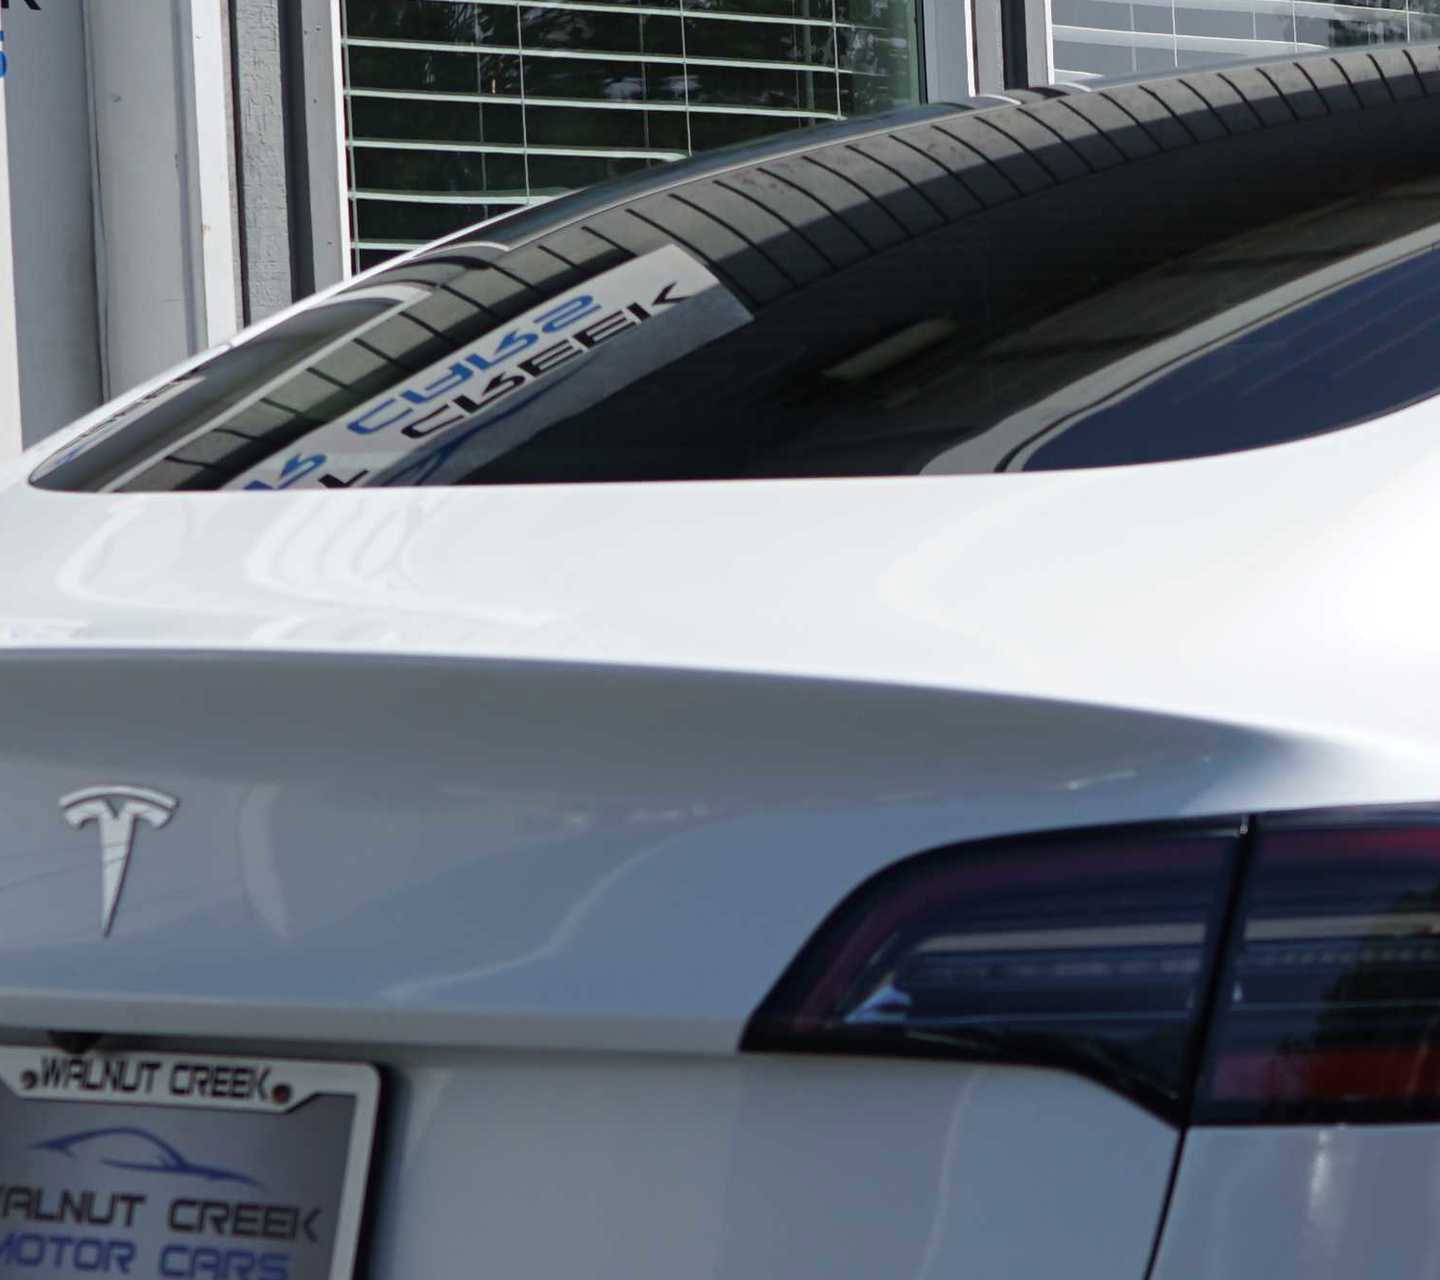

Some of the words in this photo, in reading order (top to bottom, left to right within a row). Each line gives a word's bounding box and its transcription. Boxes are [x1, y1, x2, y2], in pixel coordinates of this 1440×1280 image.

[41, 1055, 159, 1095] WALNUT
[168, 1062, 272, 1102] CREEK
[167, 1198, 323, 1243] CREEK
